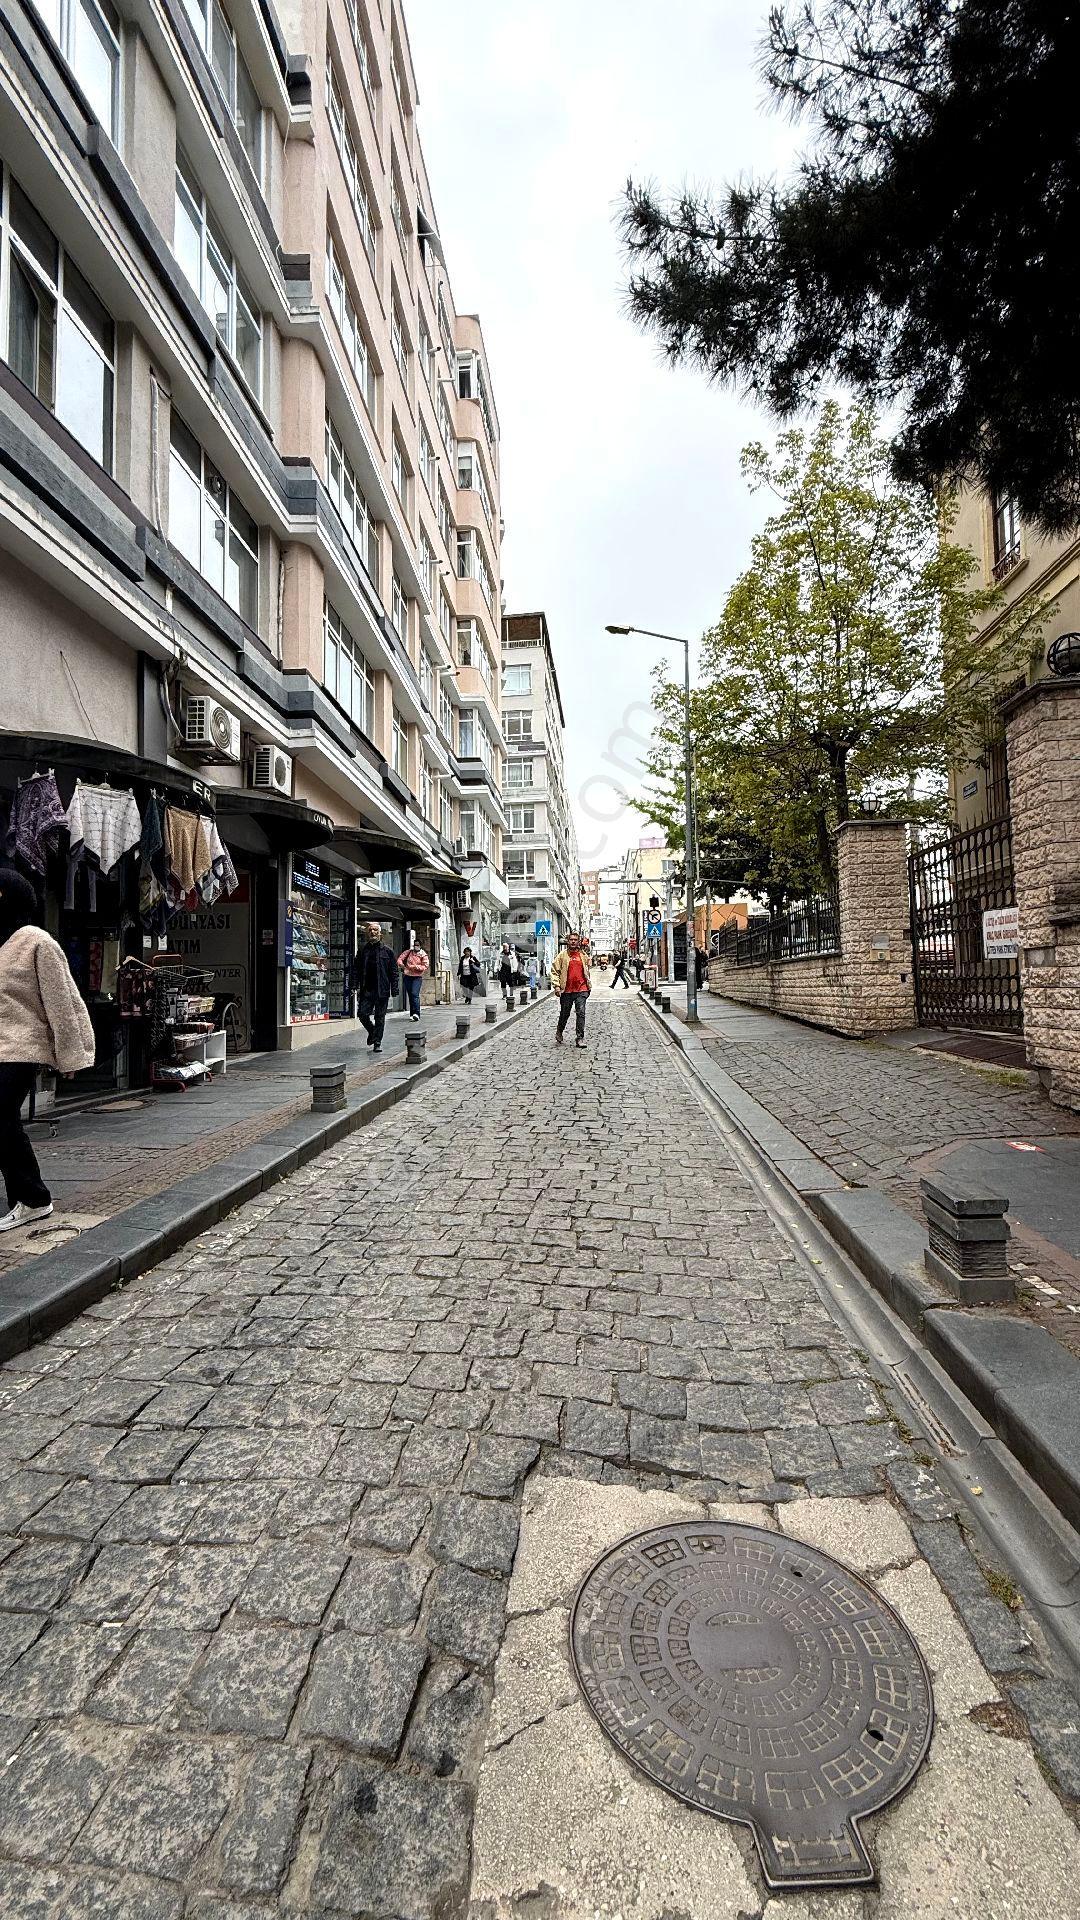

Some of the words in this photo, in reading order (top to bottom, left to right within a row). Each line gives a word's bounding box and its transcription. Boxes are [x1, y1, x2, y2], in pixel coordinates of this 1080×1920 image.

[192, 779, 211, 802] ER
[167, 939, 201, 954] ATIM
[214, 968, 241, 978] NTER
